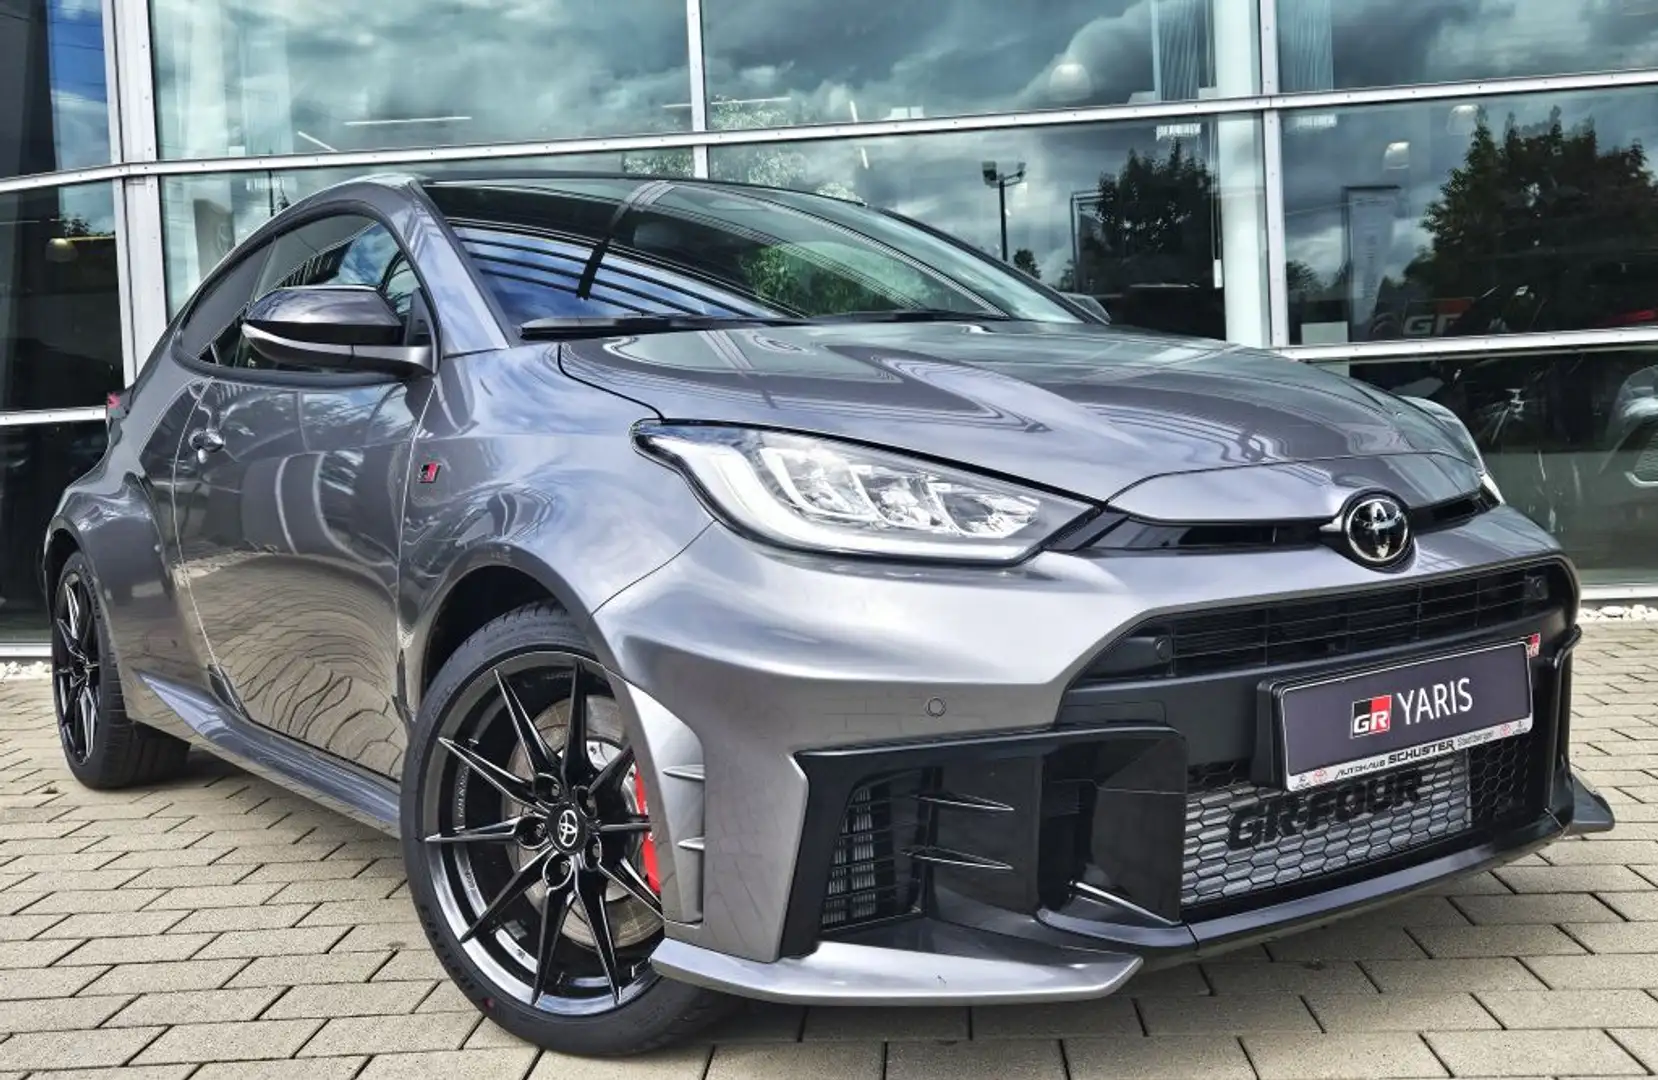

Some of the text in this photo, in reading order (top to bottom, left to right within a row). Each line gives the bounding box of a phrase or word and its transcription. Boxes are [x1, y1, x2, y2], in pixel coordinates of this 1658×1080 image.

[1353, 677, 1473, 734] GR YARIS
[1334, 740, 1456, 780] AUTOHAUS SCHUSTER
